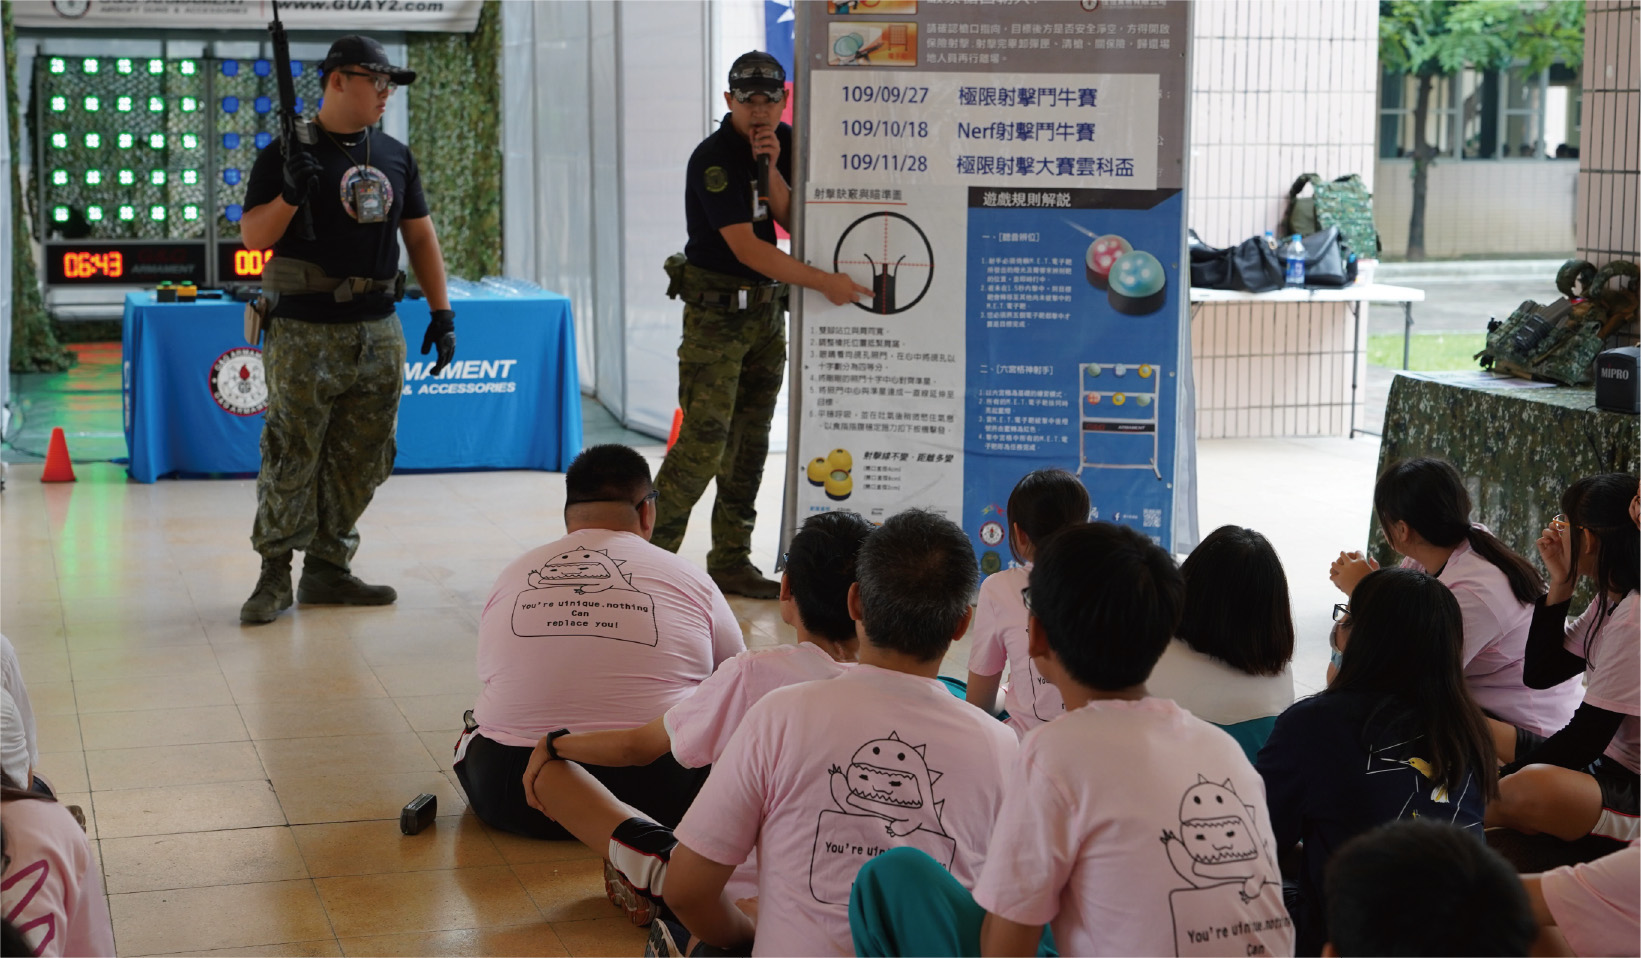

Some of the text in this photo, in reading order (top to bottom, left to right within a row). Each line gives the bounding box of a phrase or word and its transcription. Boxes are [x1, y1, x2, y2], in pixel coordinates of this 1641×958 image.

[842, 86, 1098, 108] 109/09/27 極限射擊鬥牛賽
[841, 120, 1096, 143] 109/10/18 Nerf射擊鬥牛賽
[841, 153, 928, 172] 109/11/28
[956, 155, 1135, 177] 極限射擊大賽雲科盃
[63, 251, 123, 278] 06:43
[404, 359, 517, 381] MAMENT
[1601, 368, 1629, 380] MIPRO
[418, 382, 516, 395] ACCESSORIES
[595, 621, 618, 629] you!
[825, 842, 863, 855] You're
[1187, 926, 1229, 944] You're
